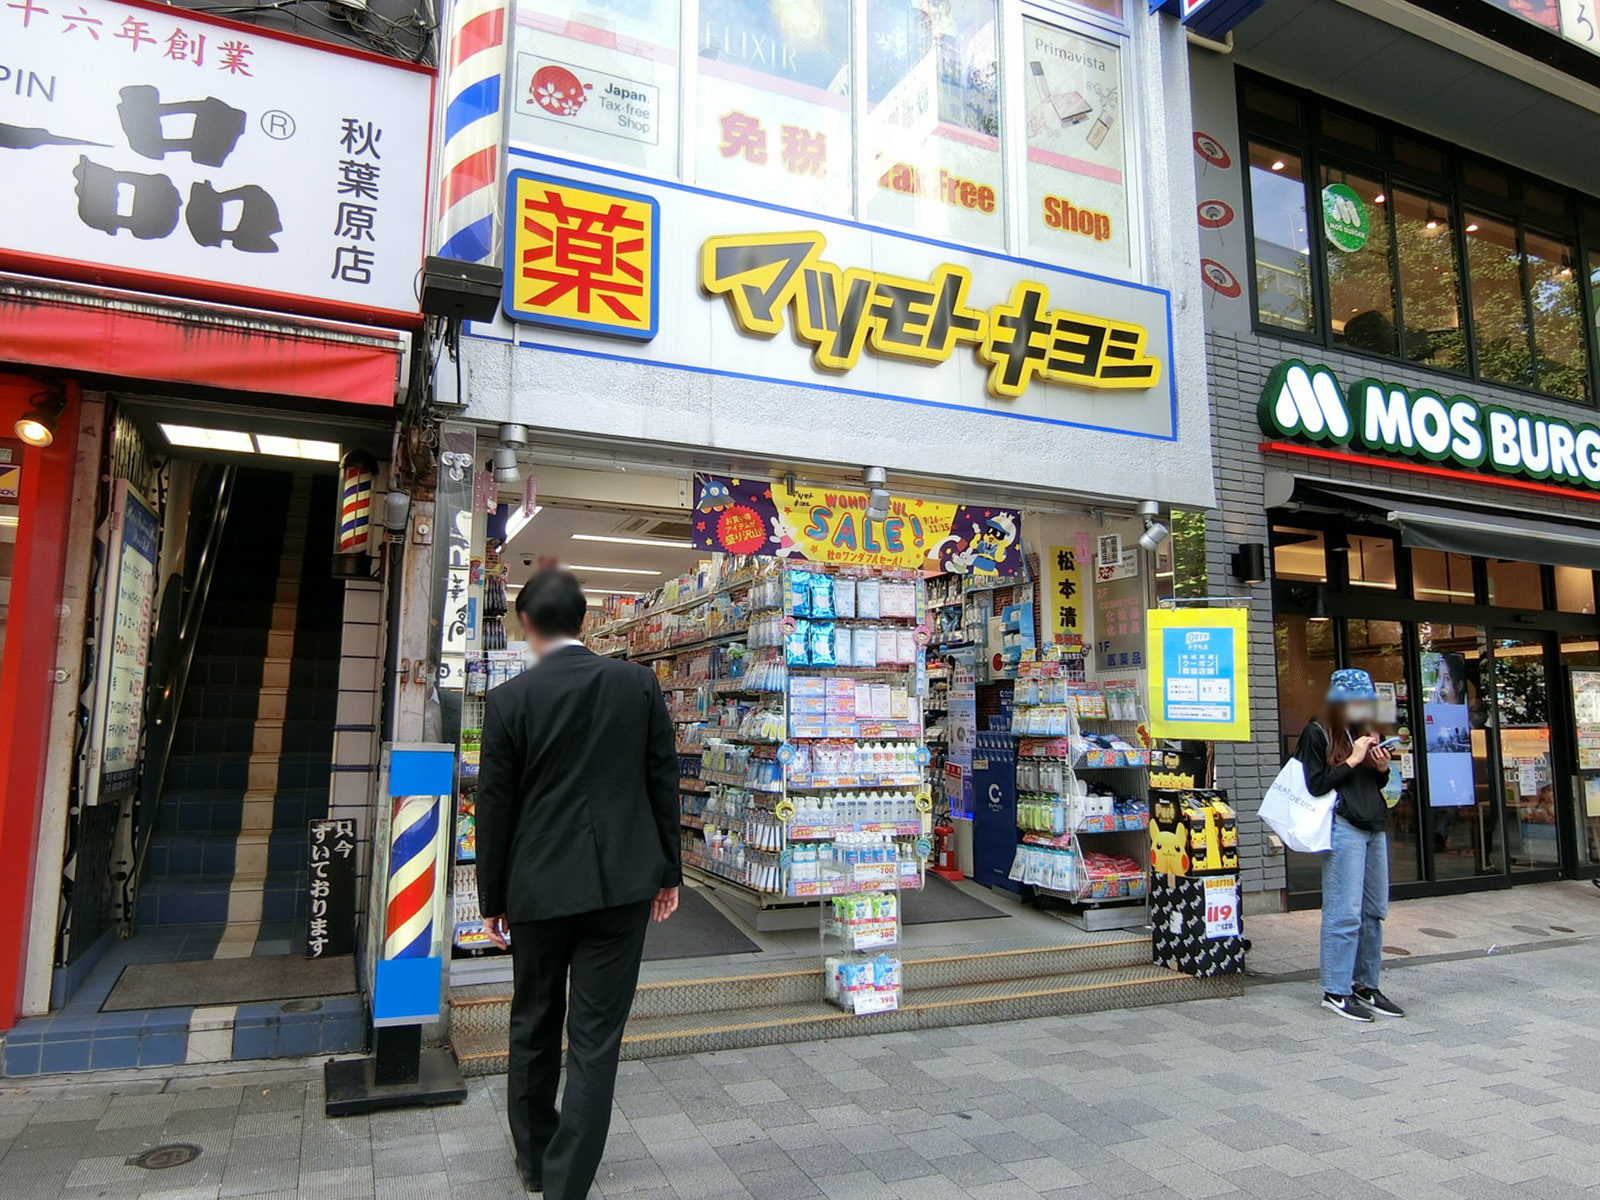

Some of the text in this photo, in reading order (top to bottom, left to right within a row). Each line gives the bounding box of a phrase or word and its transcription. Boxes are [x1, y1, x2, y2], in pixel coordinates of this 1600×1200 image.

[6, 0, 255, 77] 十六年創業
[704, 22, 798, 72] ELIXIR
[1034, 37, 1107, 73] Primavista
[599, 95, 650, 120] Tax-free
[617, 114, 650, 135] Shop
[718, 109, 829, 179] 免税
[331, 118, 382, 285] 秋葉原店
[940, 167, 997, 215] Free
[1043, 195, 1111, 242] Shop
[522, 189, 644, 322] 薬
[707, 235, 1158, 393] マツモトキヨシ
[1364, 385, 1484, 461] MOS
[803, 504, 925, 554] SALE!
[1057, 550, 1077, 628] 松本清
[1098, 641, 1110, 652] 1F
[1106, 651, 1142, 667] 医薬品
[1181, 660, 1215, 668] クーポン
[333, 820, 355, 858] 只今
[311, 824, 332, 958] すいております
[1207, 905, 1232, 923] 119
